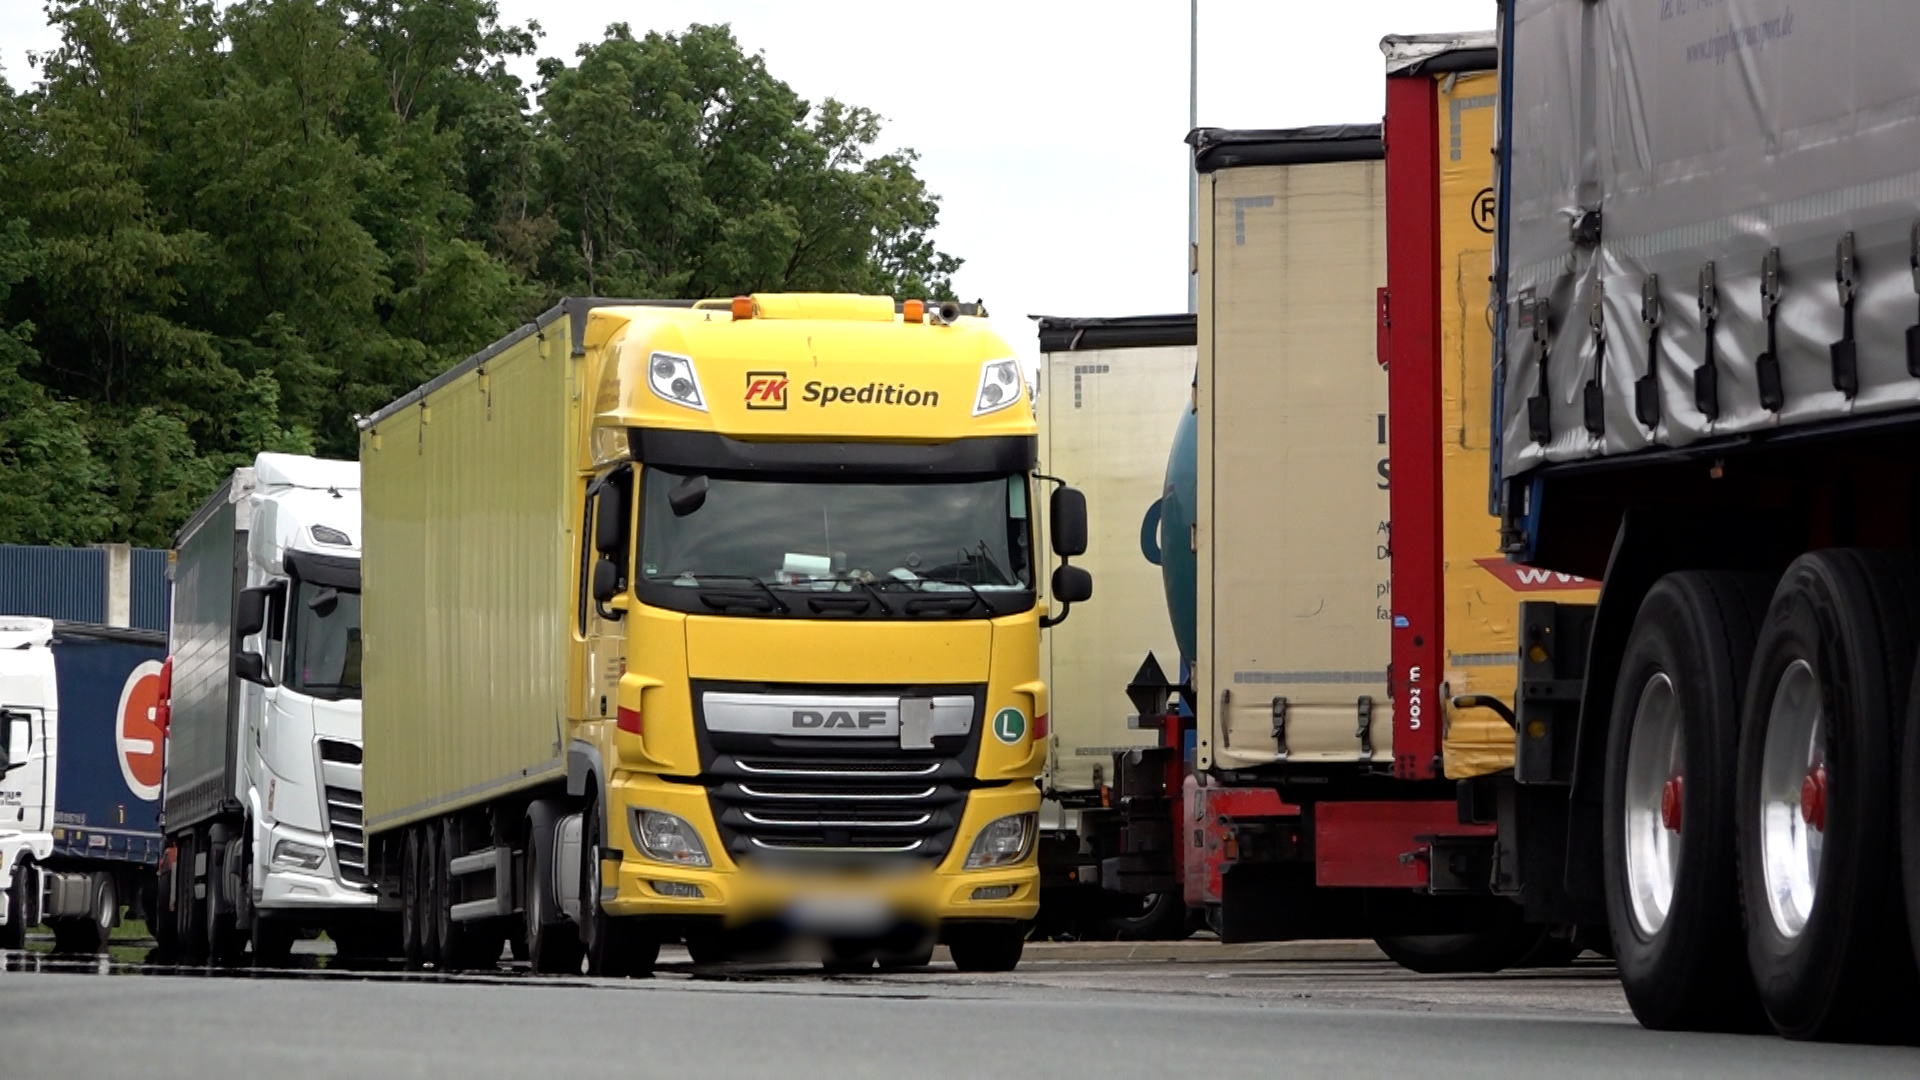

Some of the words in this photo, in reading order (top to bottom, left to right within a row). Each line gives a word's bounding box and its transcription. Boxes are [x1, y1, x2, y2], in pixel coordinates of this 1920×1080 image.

[744, 379, 789, 401] FK
[802, 381, 939, 407] Spedition
[792, 711, 887, 728] DAF
[1003, 713, 1017, 738] L
